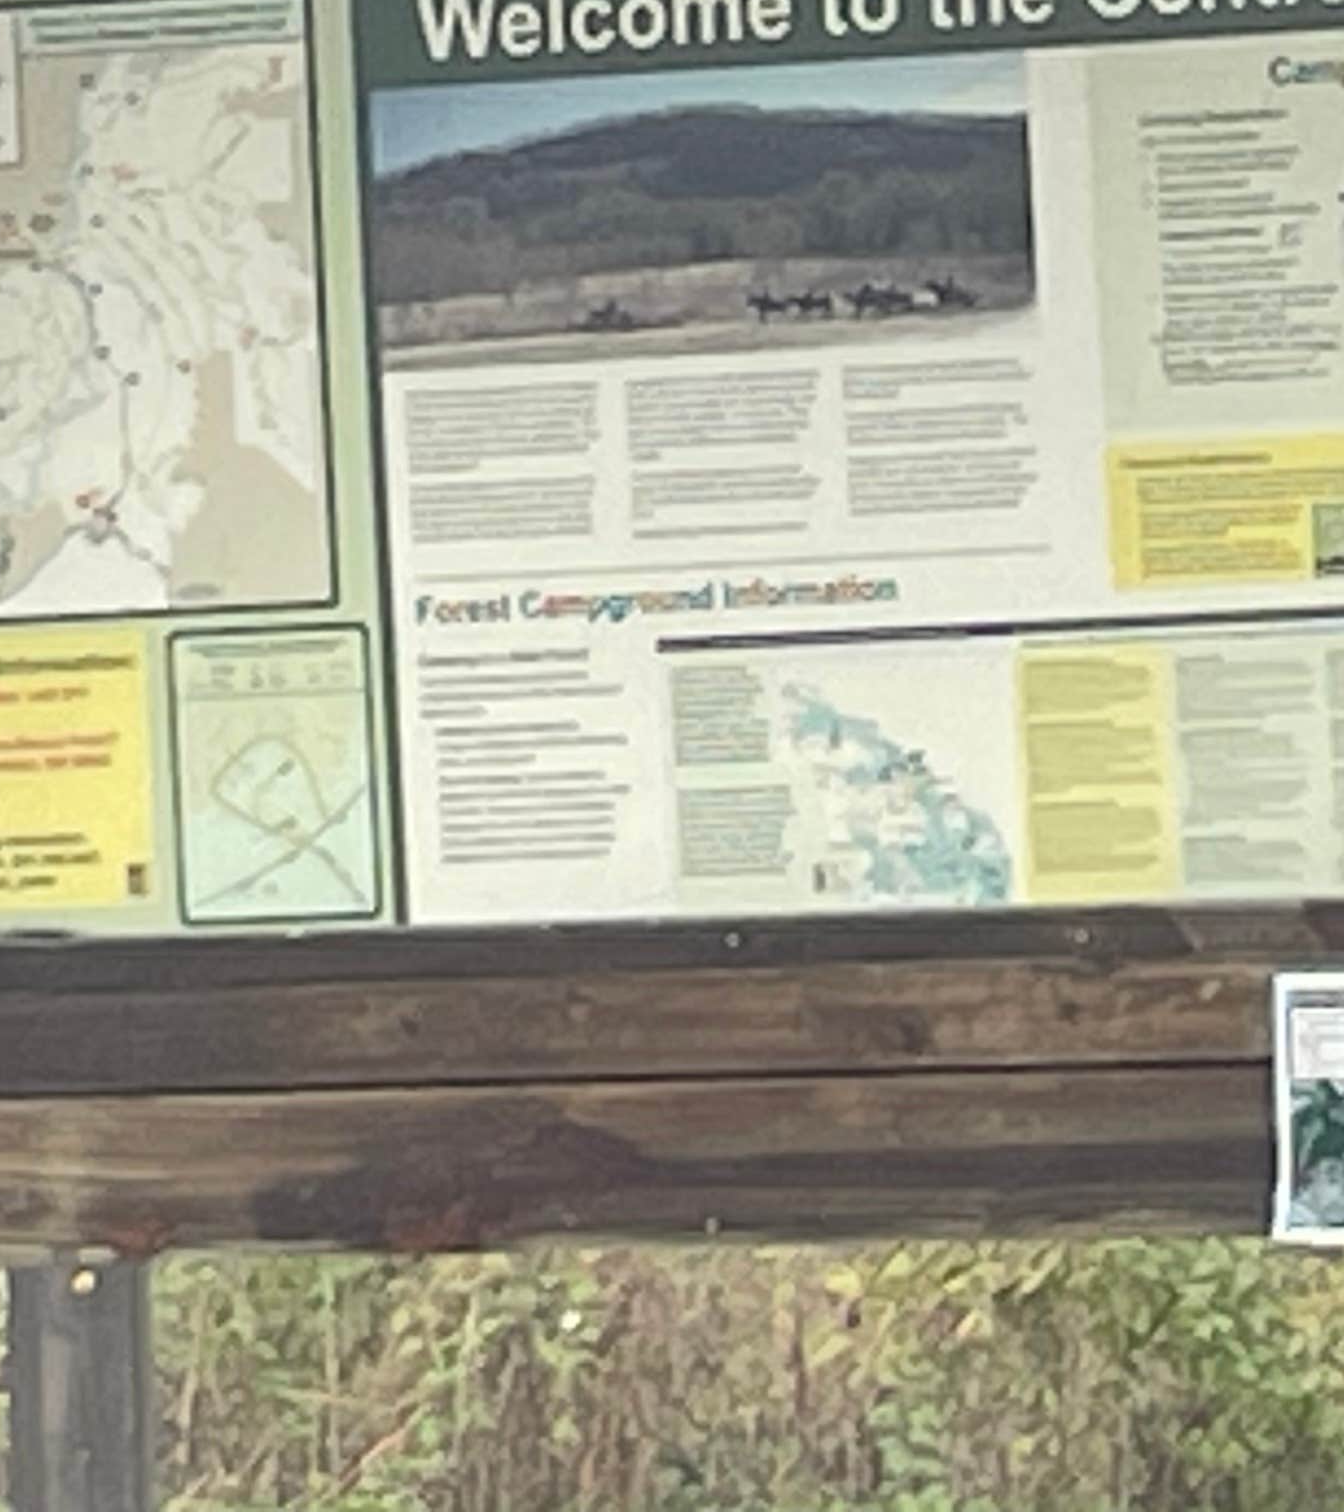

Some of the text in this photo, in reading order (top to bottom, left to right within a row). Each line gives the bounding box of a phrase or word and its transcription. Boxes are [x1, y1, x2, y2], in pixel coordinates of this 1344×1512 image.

[413, 574, 899, 626] Forest Campground Information
